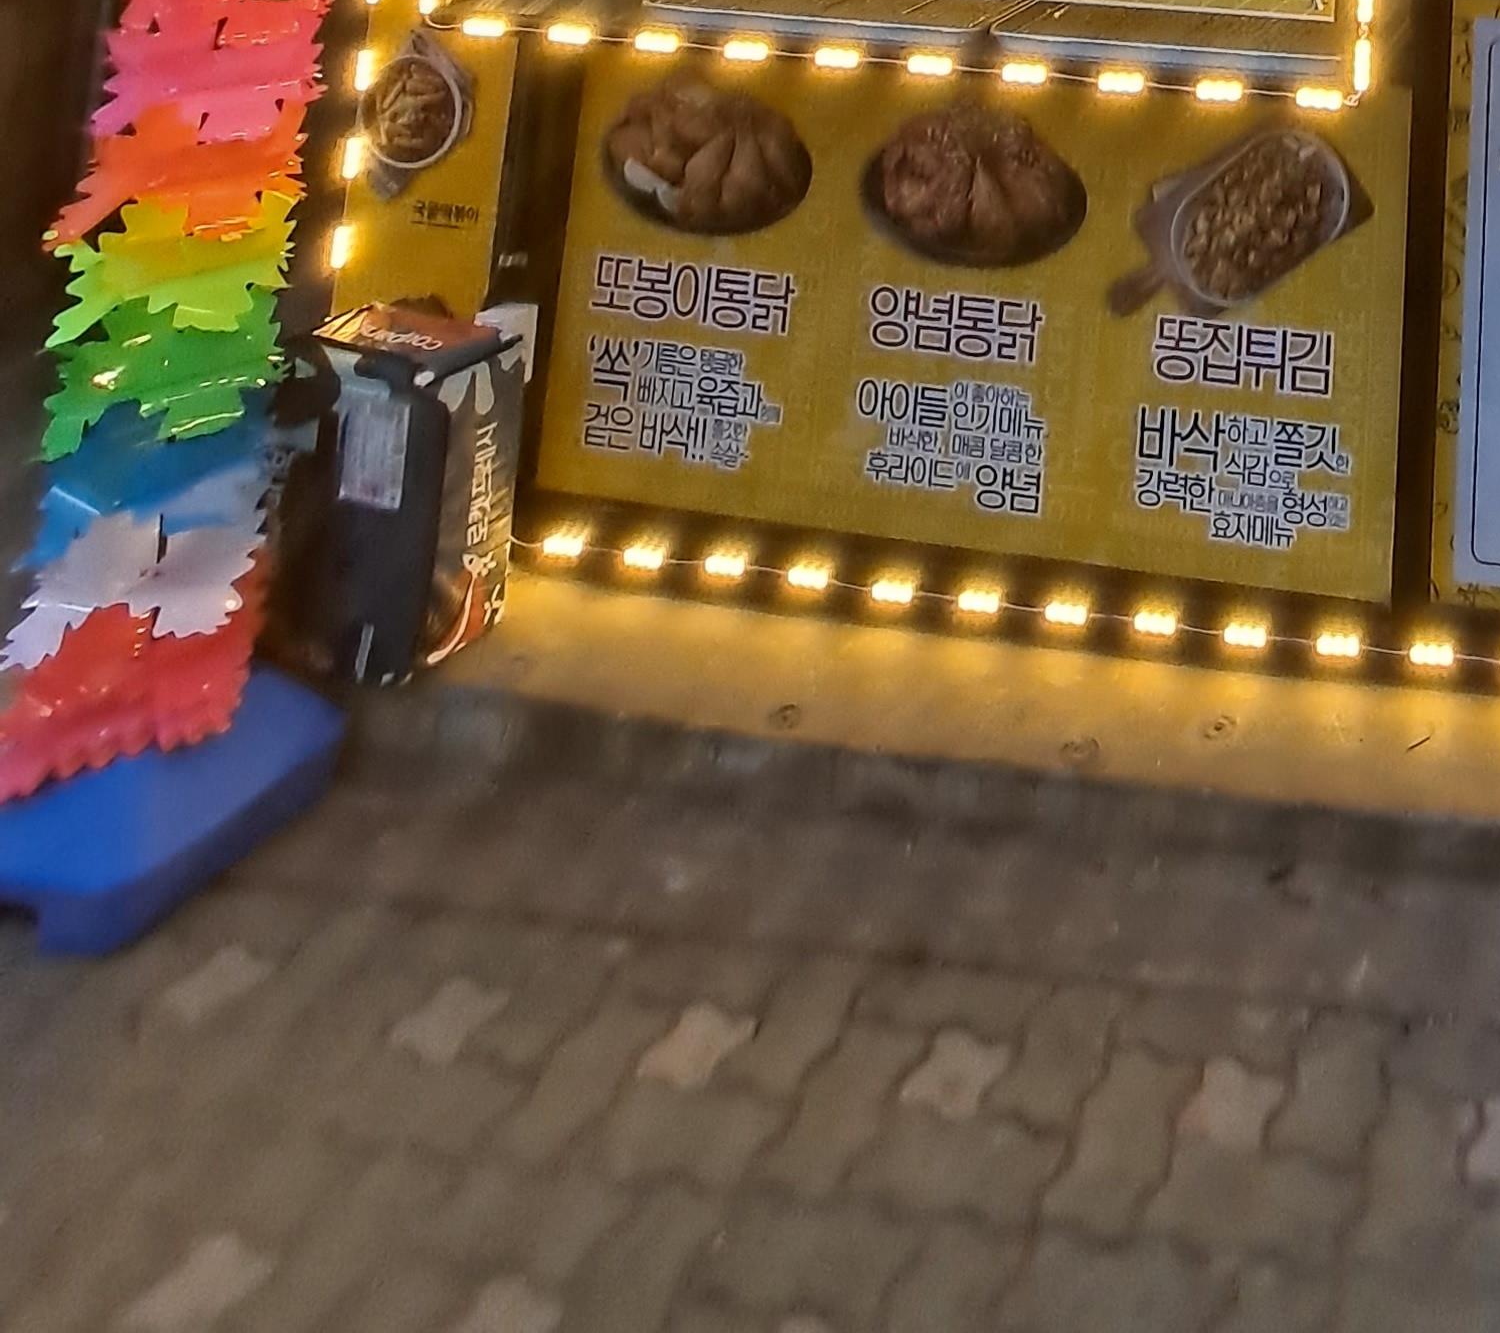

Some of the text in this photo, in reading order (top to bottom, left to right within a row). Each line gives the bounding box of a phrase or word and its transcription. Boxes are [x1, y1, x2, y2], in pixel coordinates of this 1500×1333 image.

[590, 255, 796, 334] 또봉이통닭
[871, 286, 1042, 362] 양념통닭
[641, 341, 696, 377] 기름은
[1155, 316, 1332, 395] 똥집튀김
[637, 375, 696, 414] 빠지고
[584, 402, 634, 450] 겉은
[953, 401, 1044, 440] 인기메뉴
[975, 464, 1041, 514] 양념
[1136, 468, 1215, 513] 강력한
[1211, 510, 1295, 548] 효자메뉴
